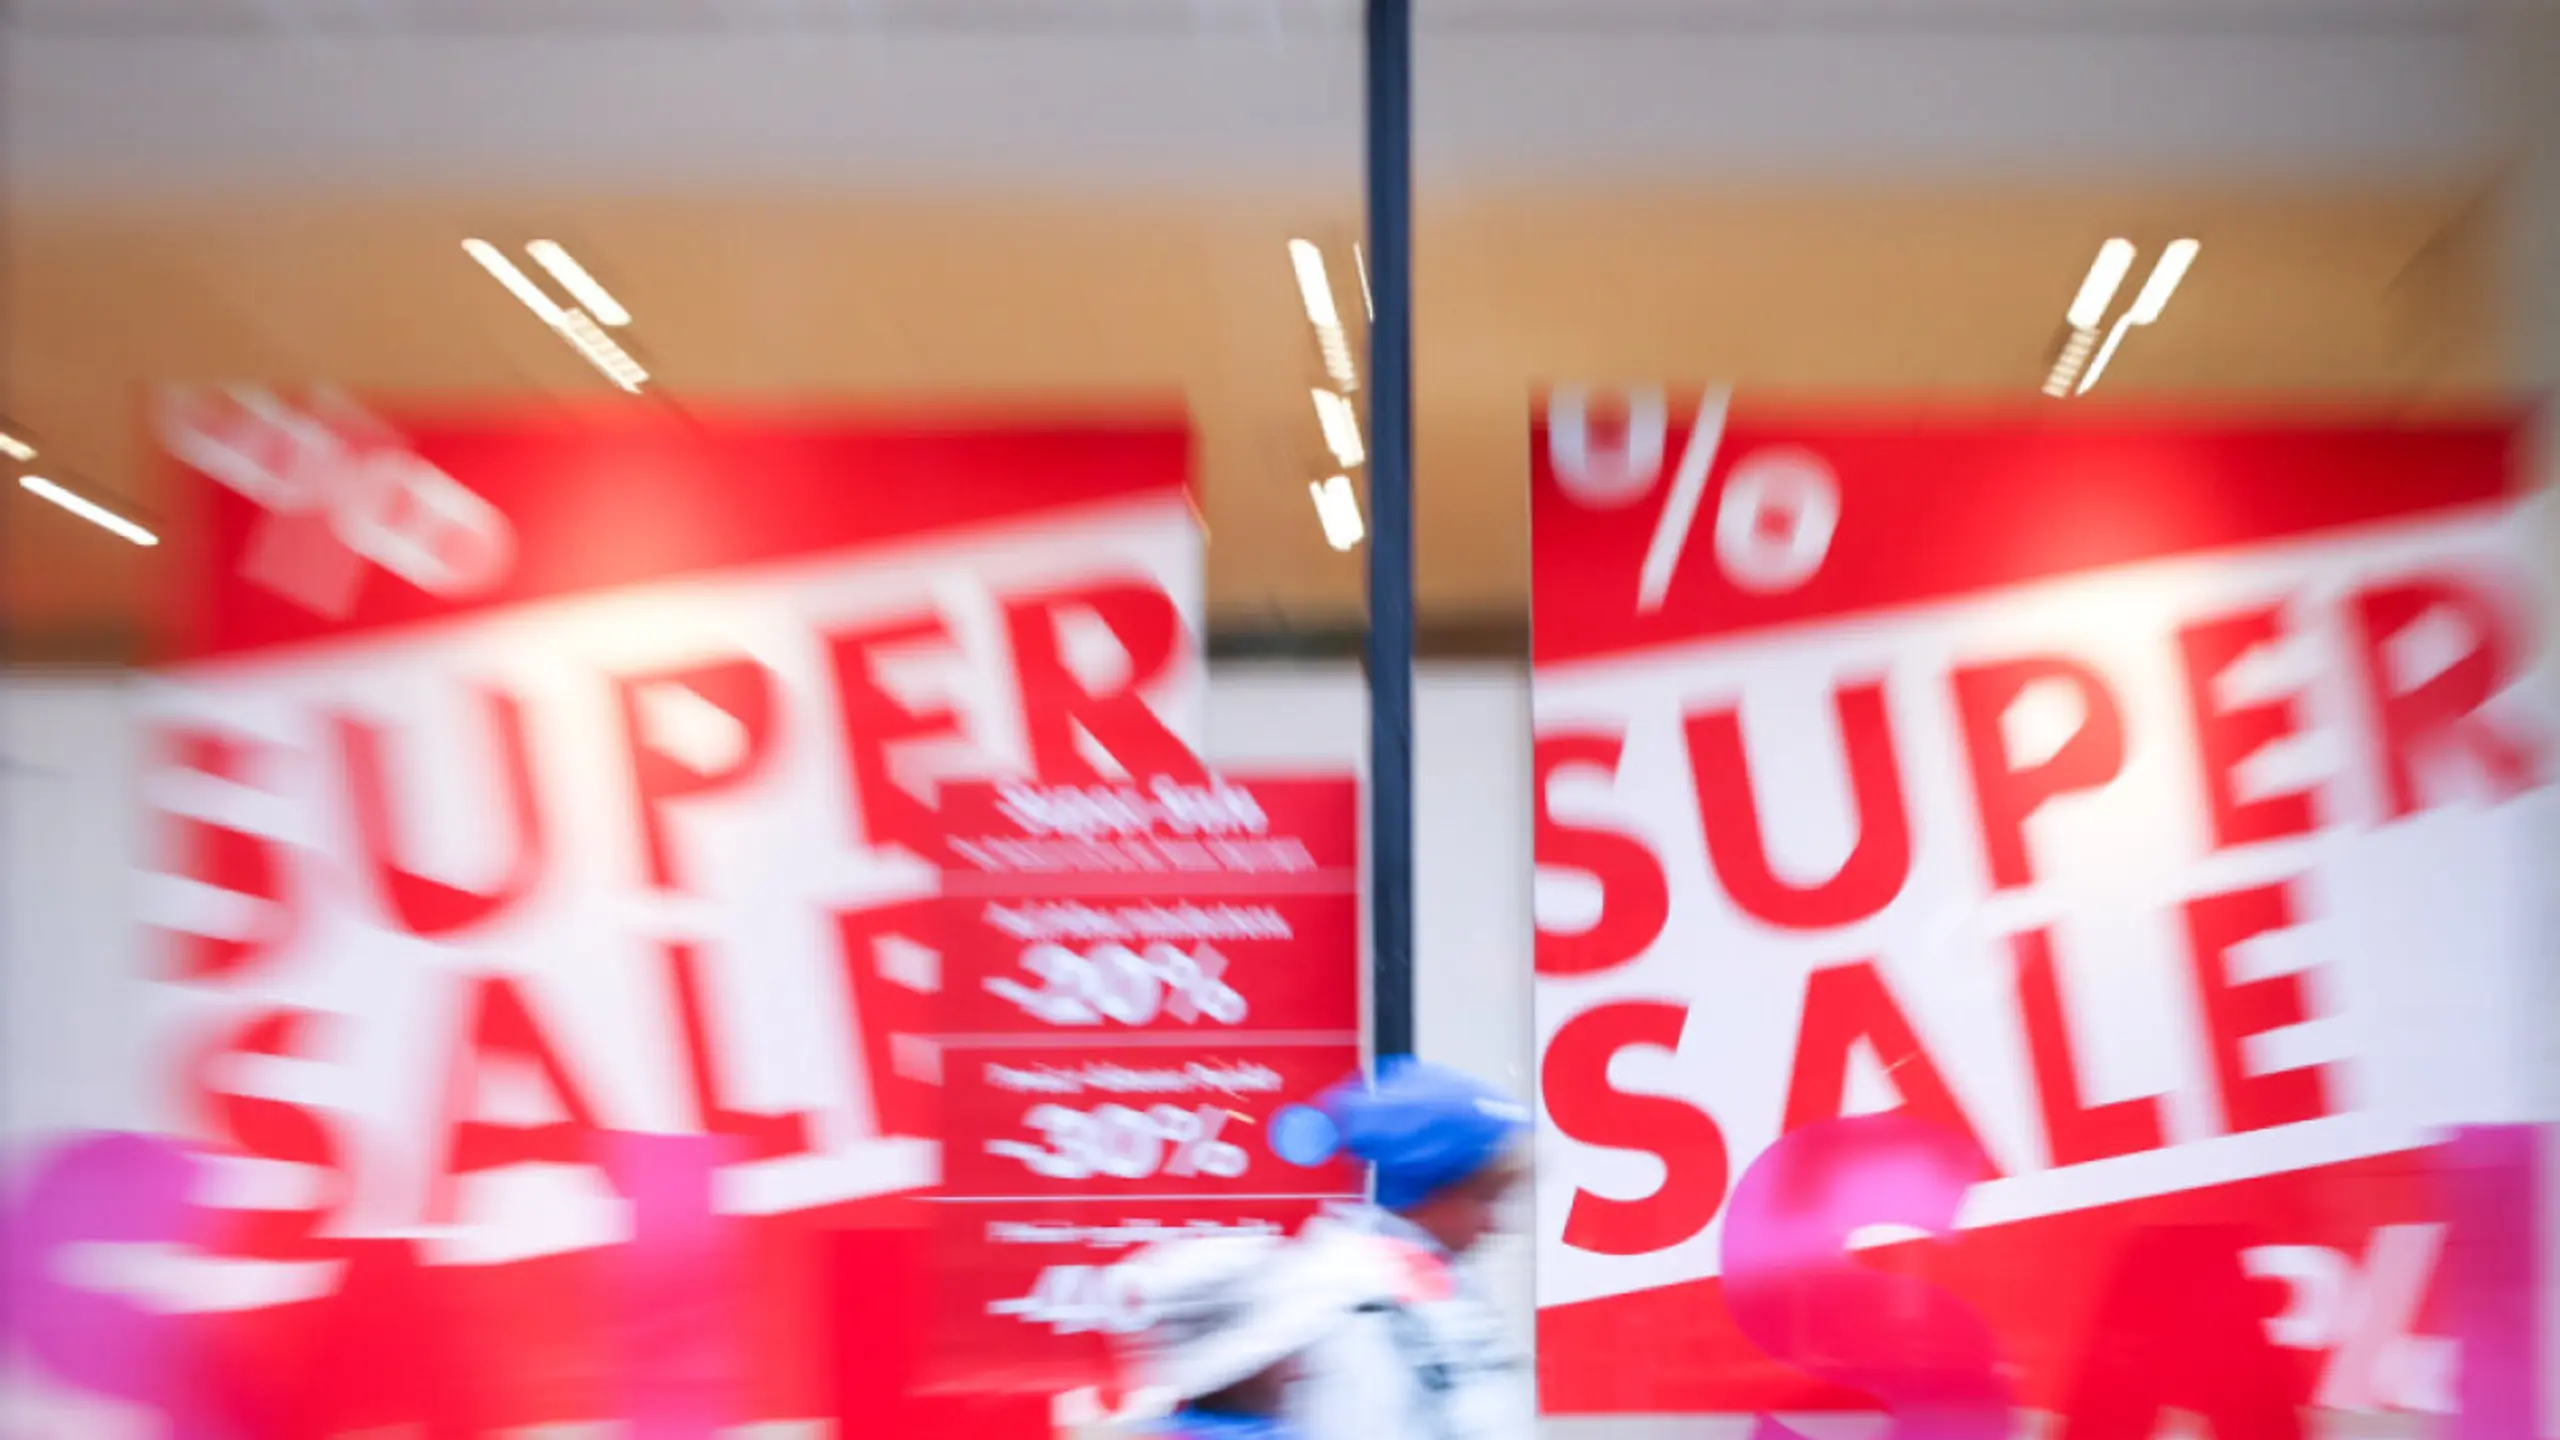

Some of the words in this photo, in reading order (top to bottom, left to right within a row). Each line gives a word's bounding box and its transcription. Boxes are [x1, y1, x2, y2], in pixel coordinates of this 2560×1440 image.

[145, 572, 1212, 983] SUPER
[1533, 568, 2550, 978] SUPER
[983, 1102, 1250, 1180] -30%
[1541, 880, 2352, 1256] SALE
